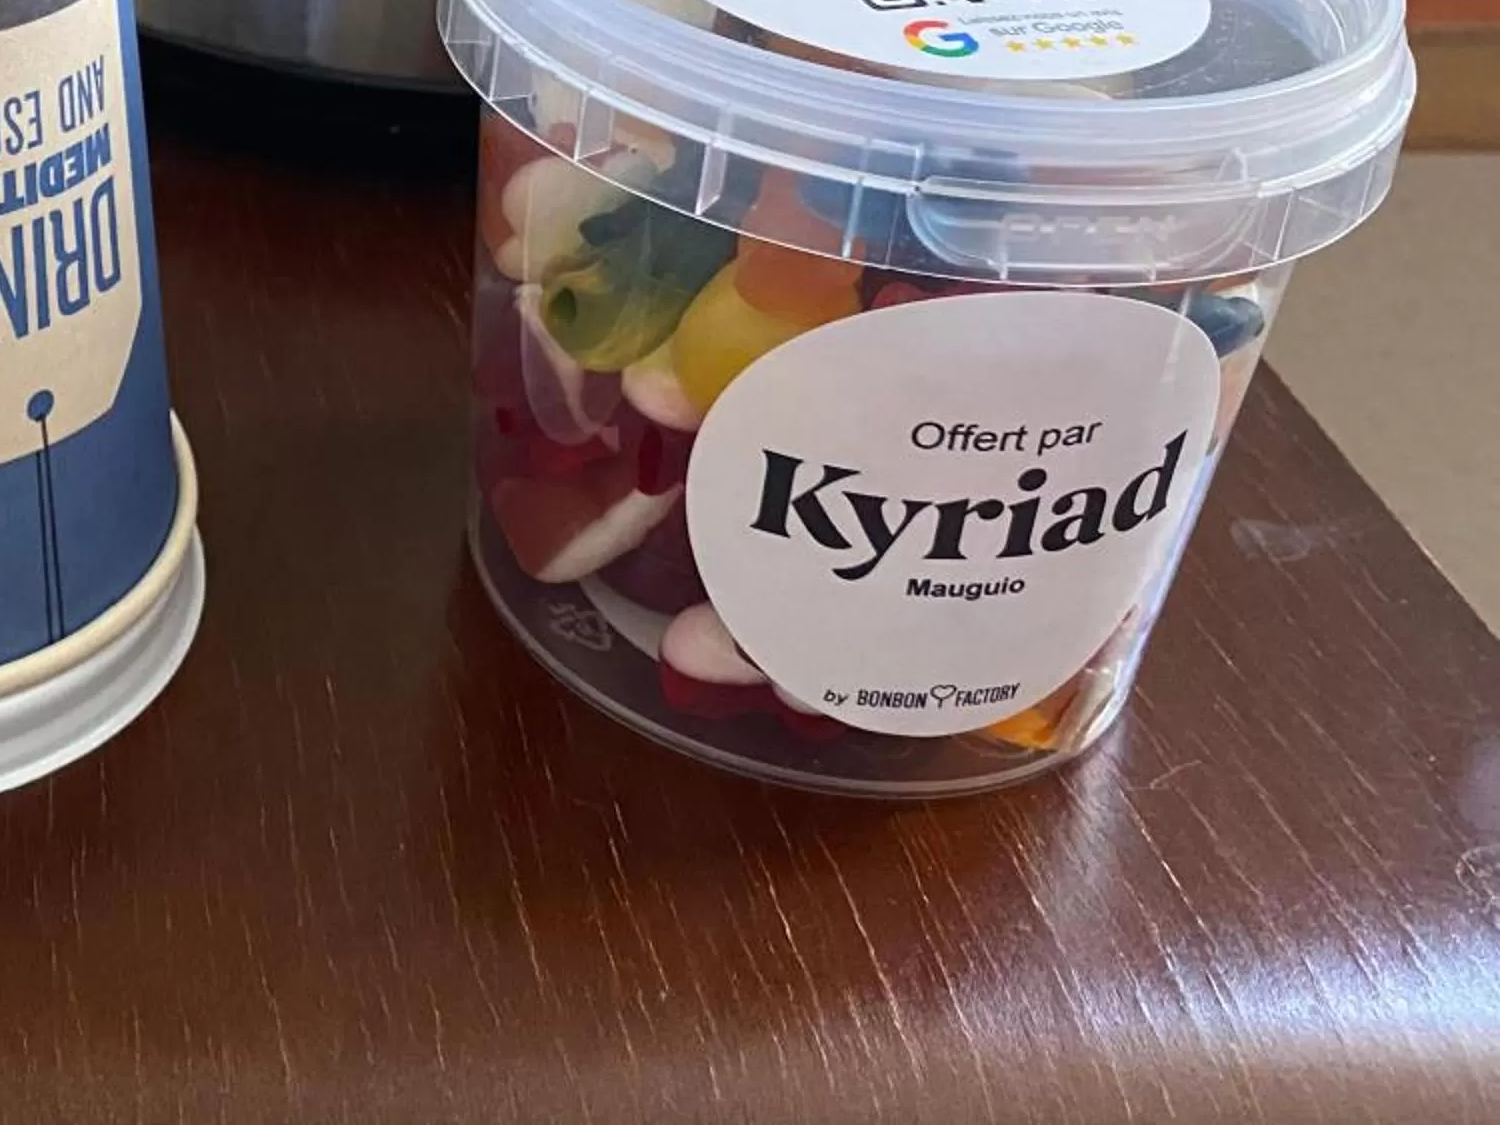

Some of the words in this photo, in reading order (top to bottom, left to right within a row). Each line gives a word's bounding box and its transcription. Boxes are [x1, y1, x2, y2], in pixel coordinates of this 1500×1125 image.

[1032, 18, 1125, 35] Google
[58, 55, 105, 133] AND
[910, 421, 1029, 453] Offert
[1036, 421, 1104, 456] par
[749, 428, 1189, 581] Kyriad
[906, 576, 1026, 602] Mauguio
[822, 688, 849, 707] by
[856, 688, 929, 710] BONBON
[954, 682, 1021, 708] FACTORY
